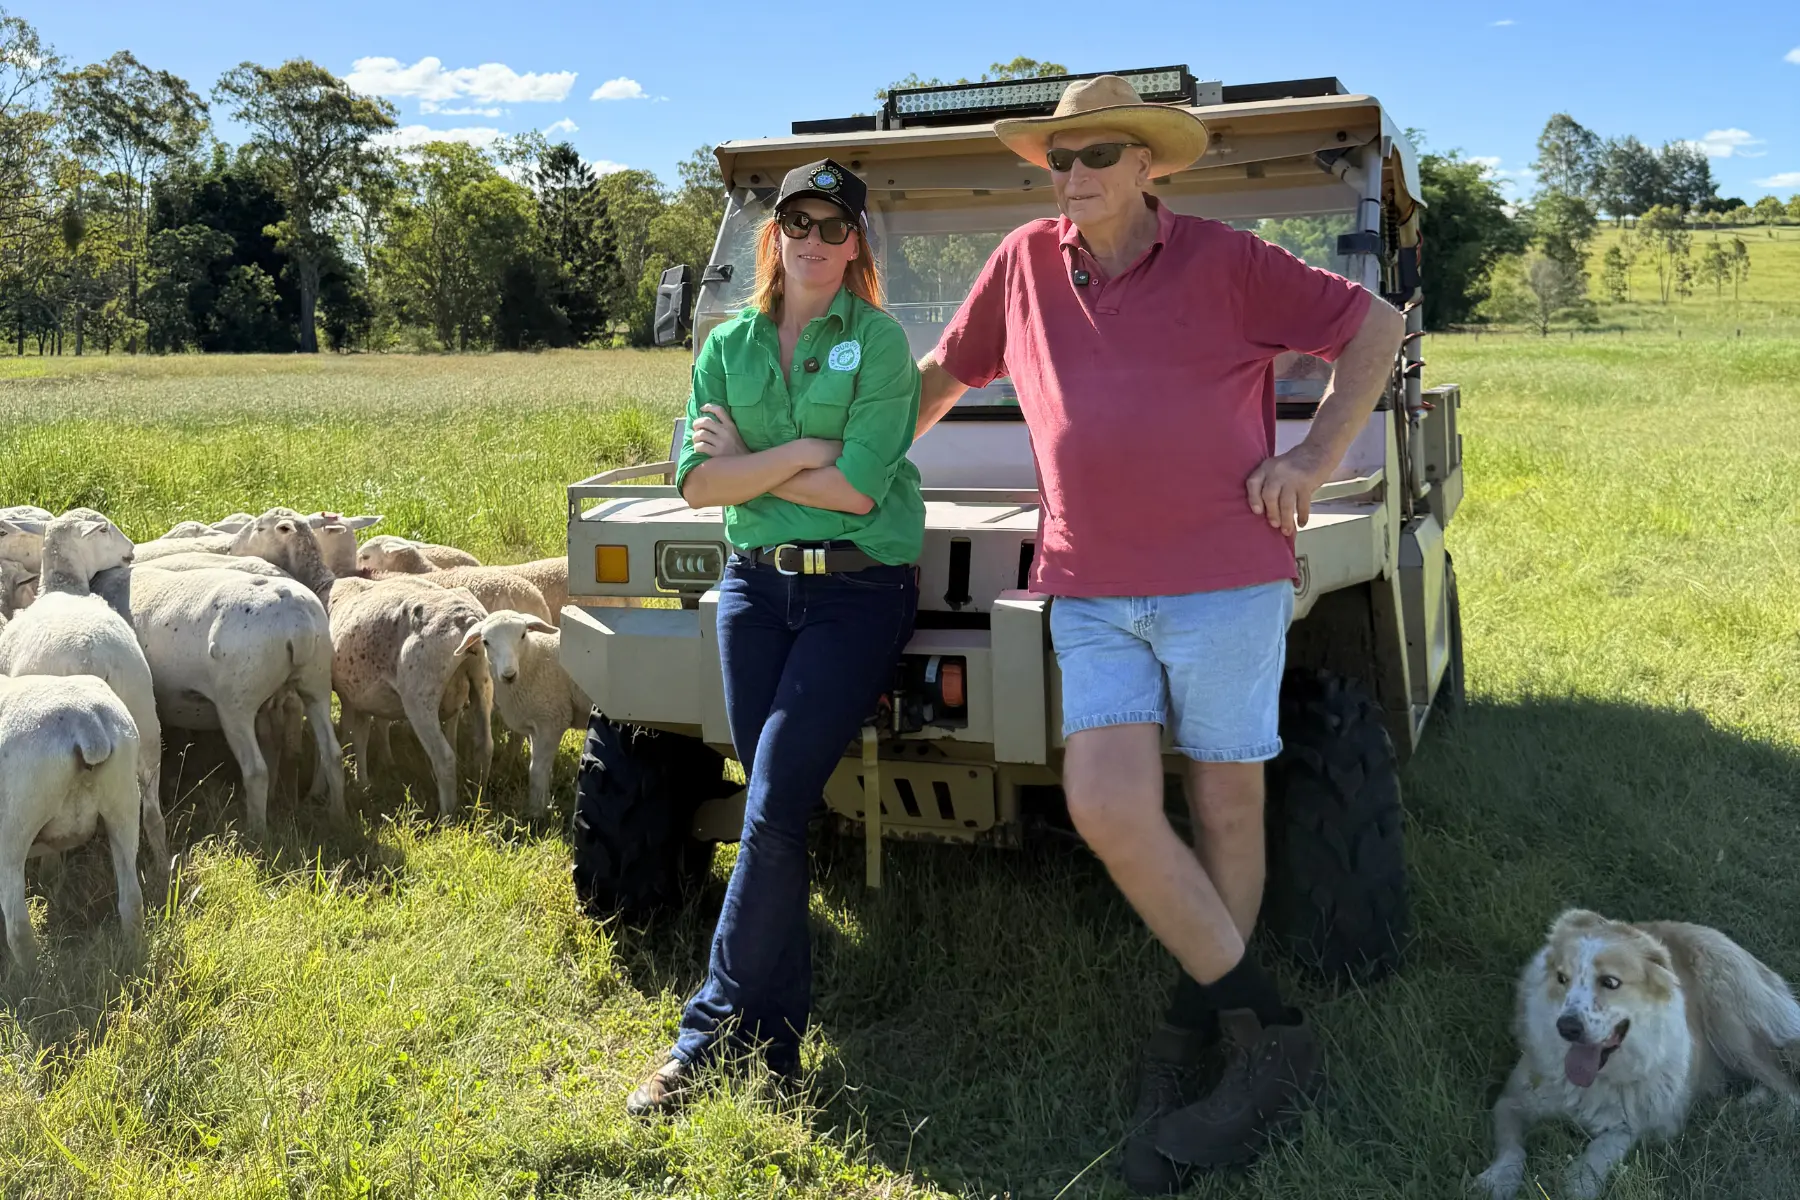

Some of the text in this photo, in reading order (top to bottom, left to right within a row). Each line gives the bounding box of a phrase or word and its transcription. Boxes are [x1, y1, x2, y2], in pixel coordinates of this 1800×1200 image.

[810, 164, 844, 180] OUR COW
[834, 342, 850, 352] OUR
